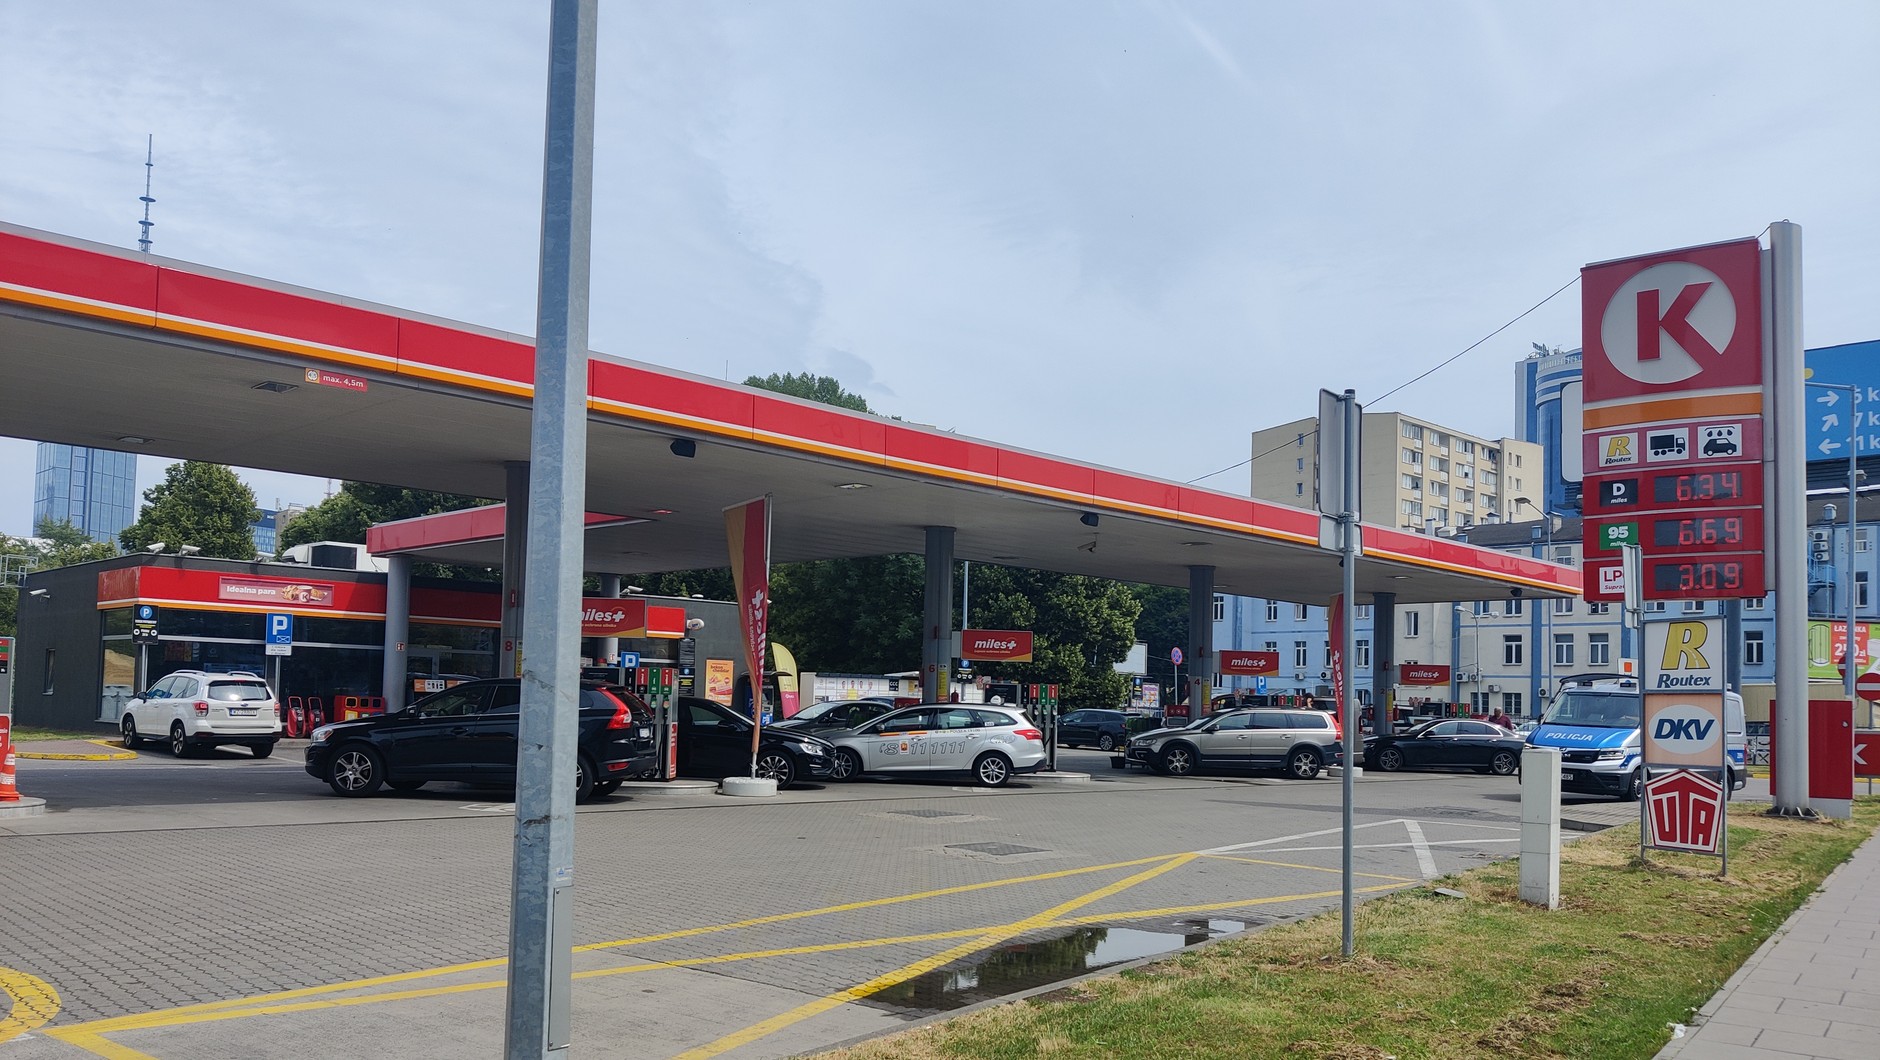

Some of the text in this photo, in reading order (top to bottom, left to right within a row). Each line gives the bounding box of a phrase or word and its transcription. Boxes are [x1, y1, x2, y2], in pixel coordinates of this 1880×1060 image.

[1637, 281, 1721, 372] K
[323, 375, 342, 384] max.
[343, 378, 363, 388] 4,5m
[1846, 435, 1864, 450] 1
[1605, 457, 1632, 465] Routex
[1612, 483, 1626, 496] D
[1677, 472, 1738, 501] 6.34
[1608, 525, 1629, 539] 95
[1679, 518, 1740, 545] 6.69
[1604, 570, 1624, 582] LP
[1679, 563, 1740, 590] 3.09
[226, 585, 276, 596] Idealna para
[272, 615, 288, 636] P
[505, 640, 513, 652] 8
[974, 639, 1017, 650] miles+
[1661, 620, 1711, 670] R
[929, 664, 936, 673] 6
[1231, 657, 1267, 667] miles+
[1409, 670, 1440, 679] miles+
[1657, 673, 1712, 689] Routex
[1258, 676, 1265, 689] P
[1654, 718, 1716, 741] DKV
[1545, 732, 1593, 741] POLICJA
[1651, 775, 1719, 847] UTA
